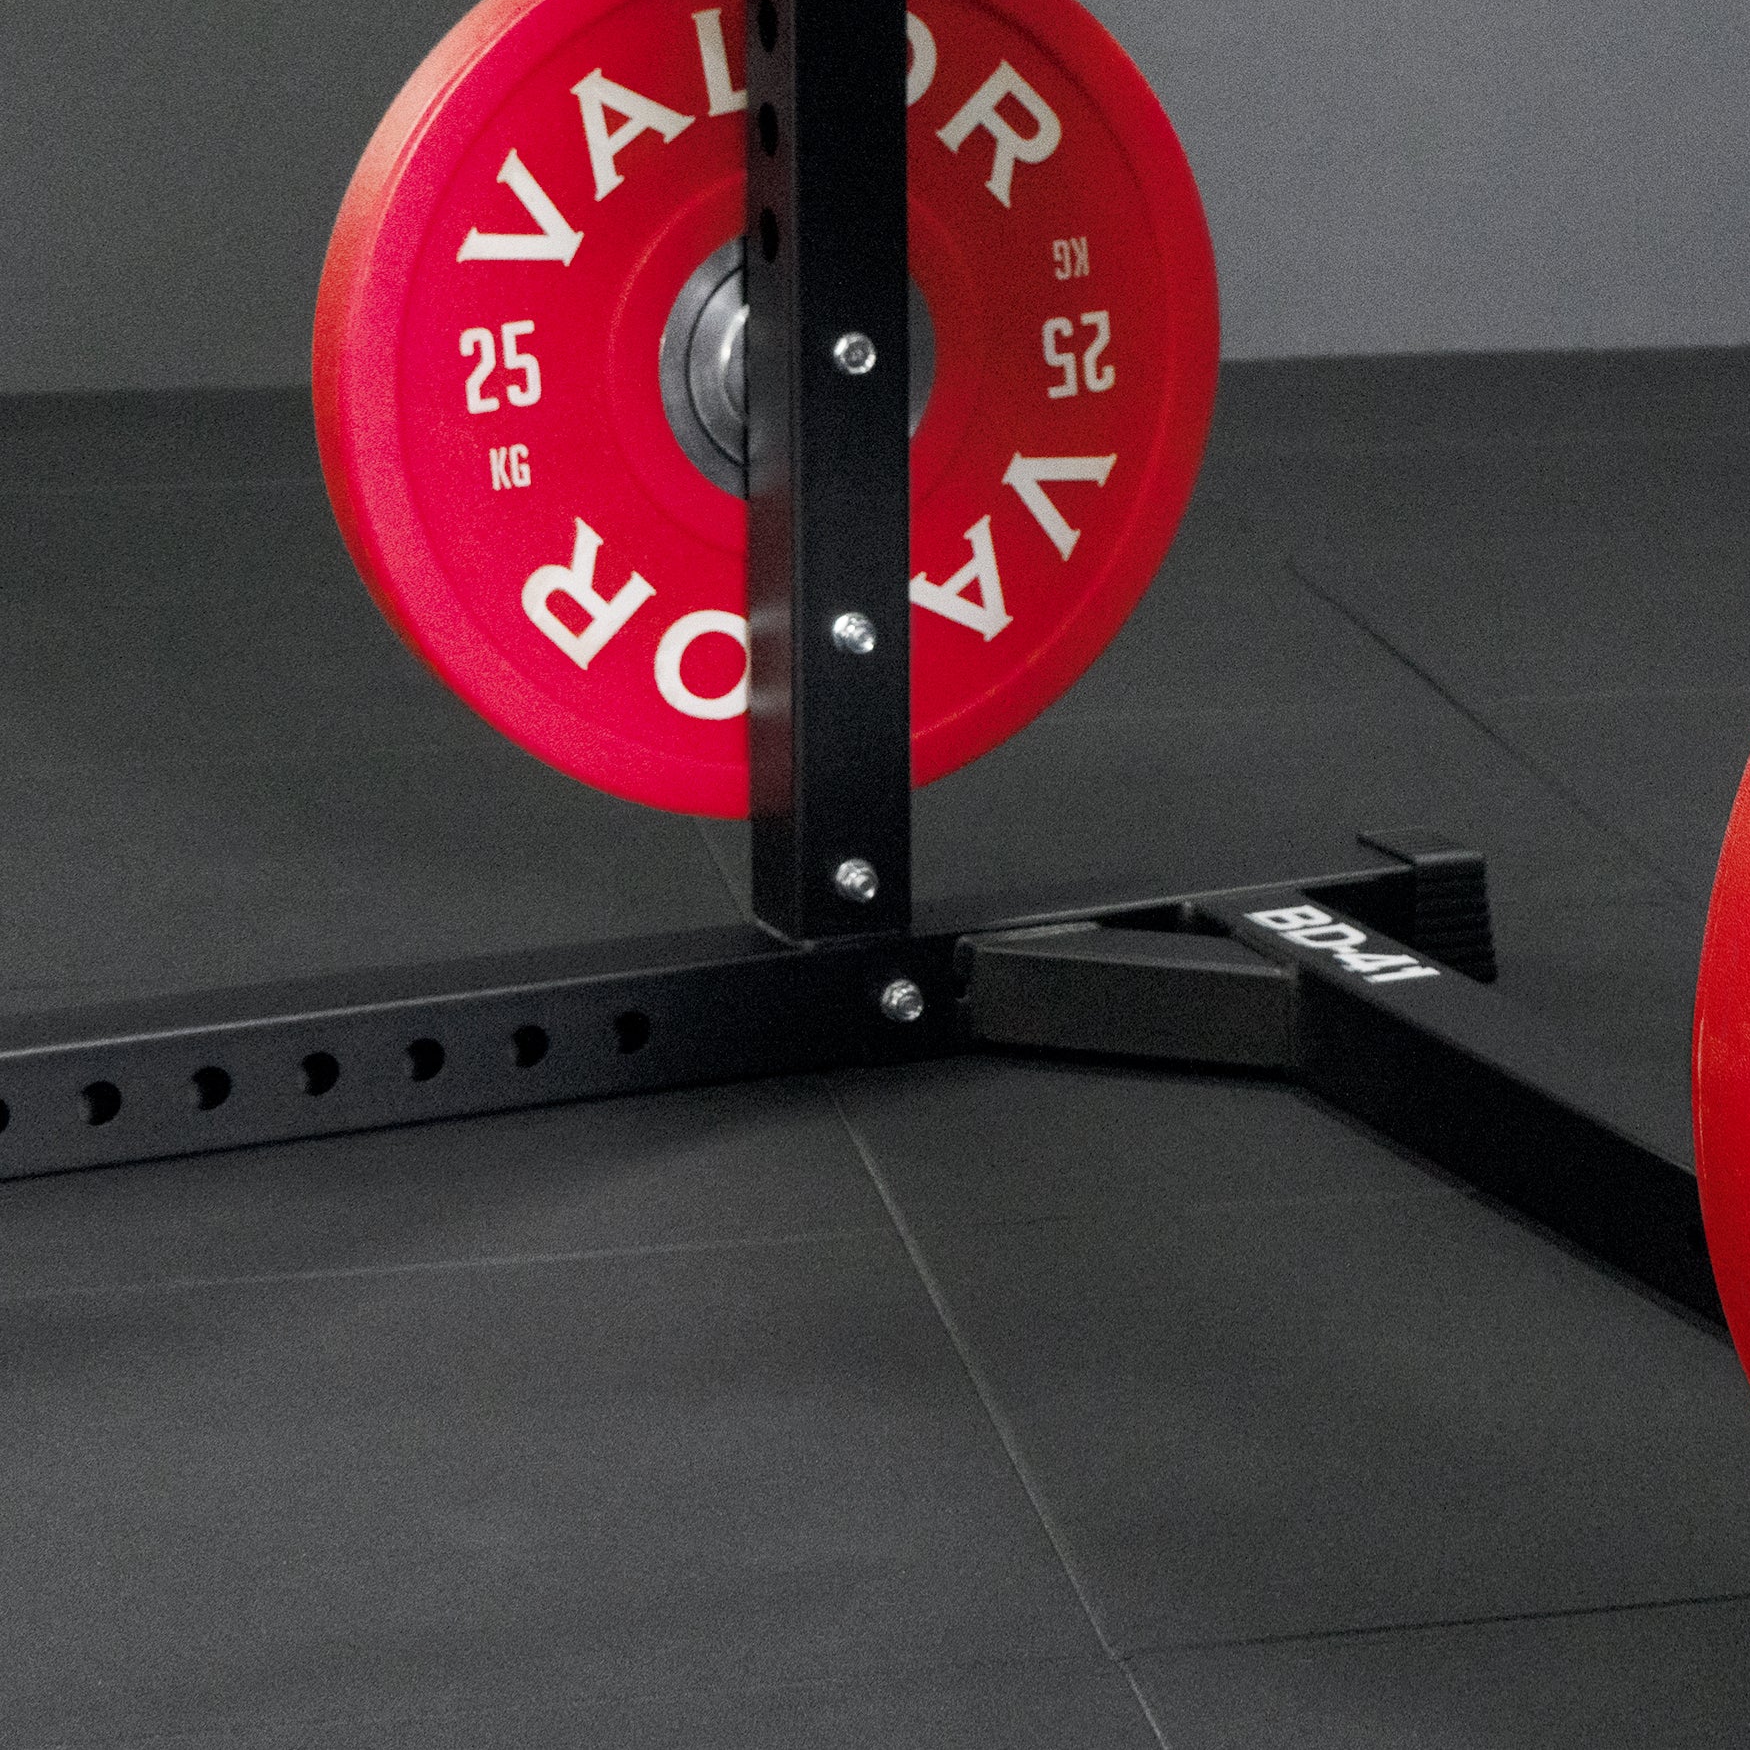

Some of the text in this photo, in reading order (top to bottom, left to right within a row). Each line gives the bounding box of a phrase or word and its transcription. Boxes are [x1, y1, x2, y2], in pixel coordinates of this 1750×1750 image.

[1052, 237, 1089, 282] KG
[460, 320, 542, 414] 25
[1043, 311, 1116, 398] 25
[490, 444, 532, 491] KG
[522, 453, 1116, 720] VAOR
[1244, 904, 1441, 985] BD-41
